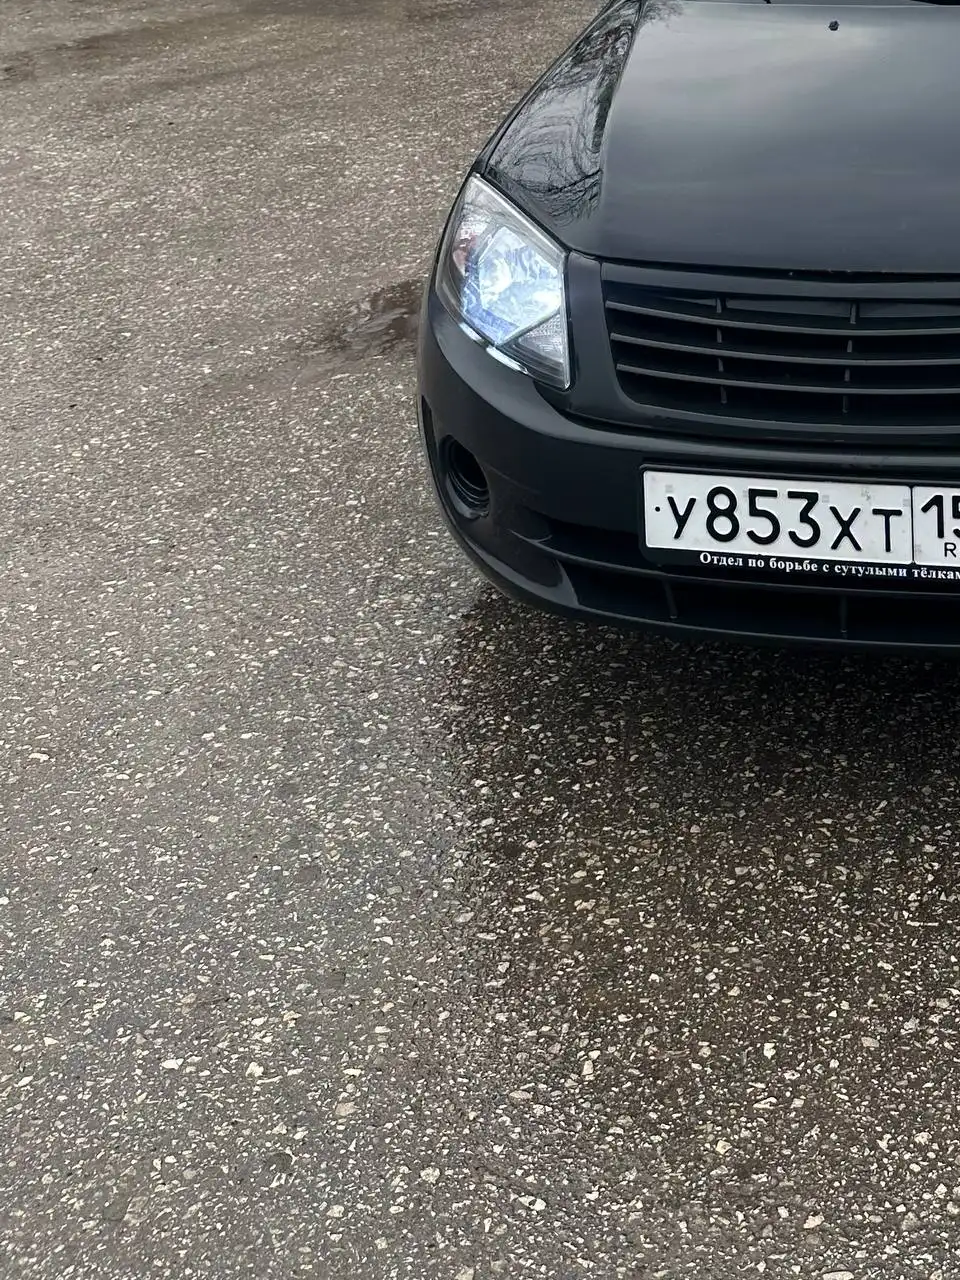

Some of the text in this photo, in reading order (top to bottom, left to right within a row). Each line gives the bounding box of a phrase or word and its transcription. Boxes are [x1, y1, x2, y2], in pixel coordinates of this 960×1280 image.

[699, 552, 744, 567] Отдел
[748, 557, 765, 569] по
[769, 557, 818, 572] борьбе
[822, 564, 830, 573] с
[834, 565, 907, 578] сутулыми
